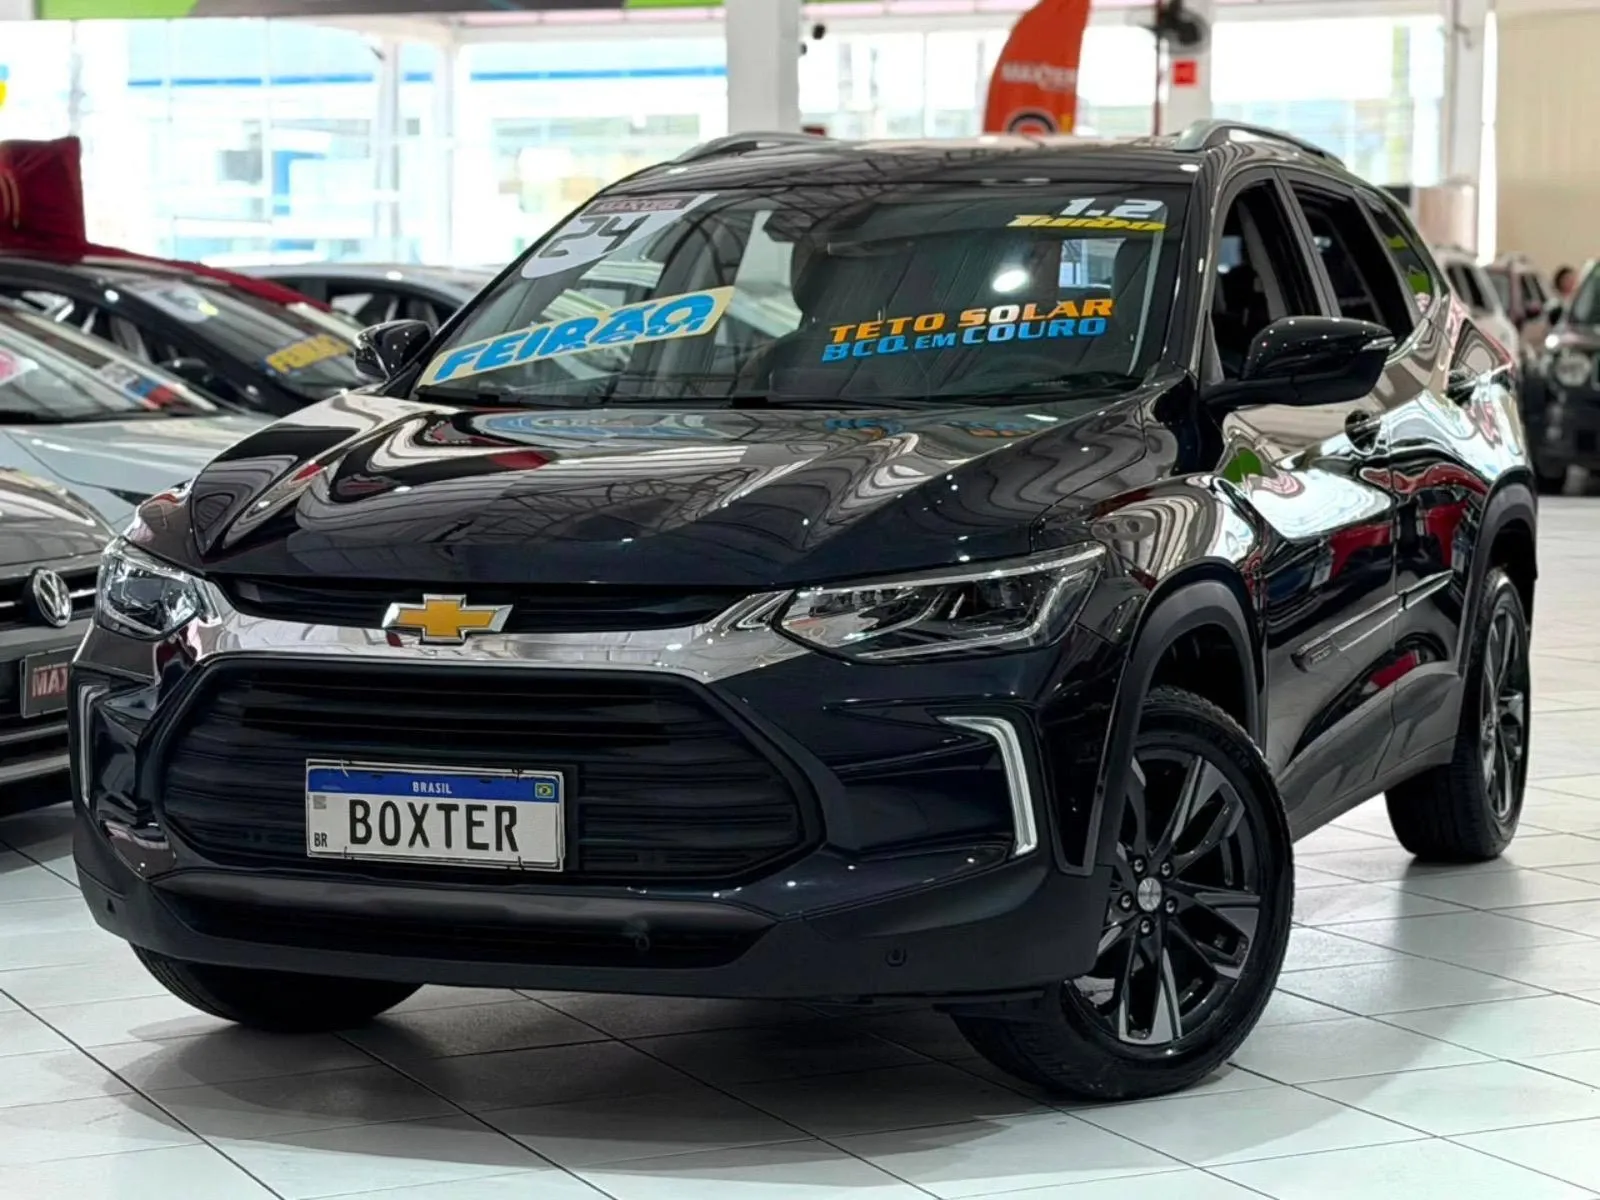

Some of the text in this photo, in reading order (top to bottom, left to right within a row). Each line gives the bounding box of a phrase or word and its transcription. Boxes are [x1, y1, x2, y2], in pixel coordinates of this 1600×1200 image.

[1059, 197, 1164, 219] 1.2
[830, 298, 1114, 344] TETO SOLAR
[914, 332, 957, 350] EM
[961, 317, 1107, 345] COURO
[412, 781, 452, 794] BRASIL
[349, 799, 519, 852] BOXTER
[313, 832, 328, 848] BR
